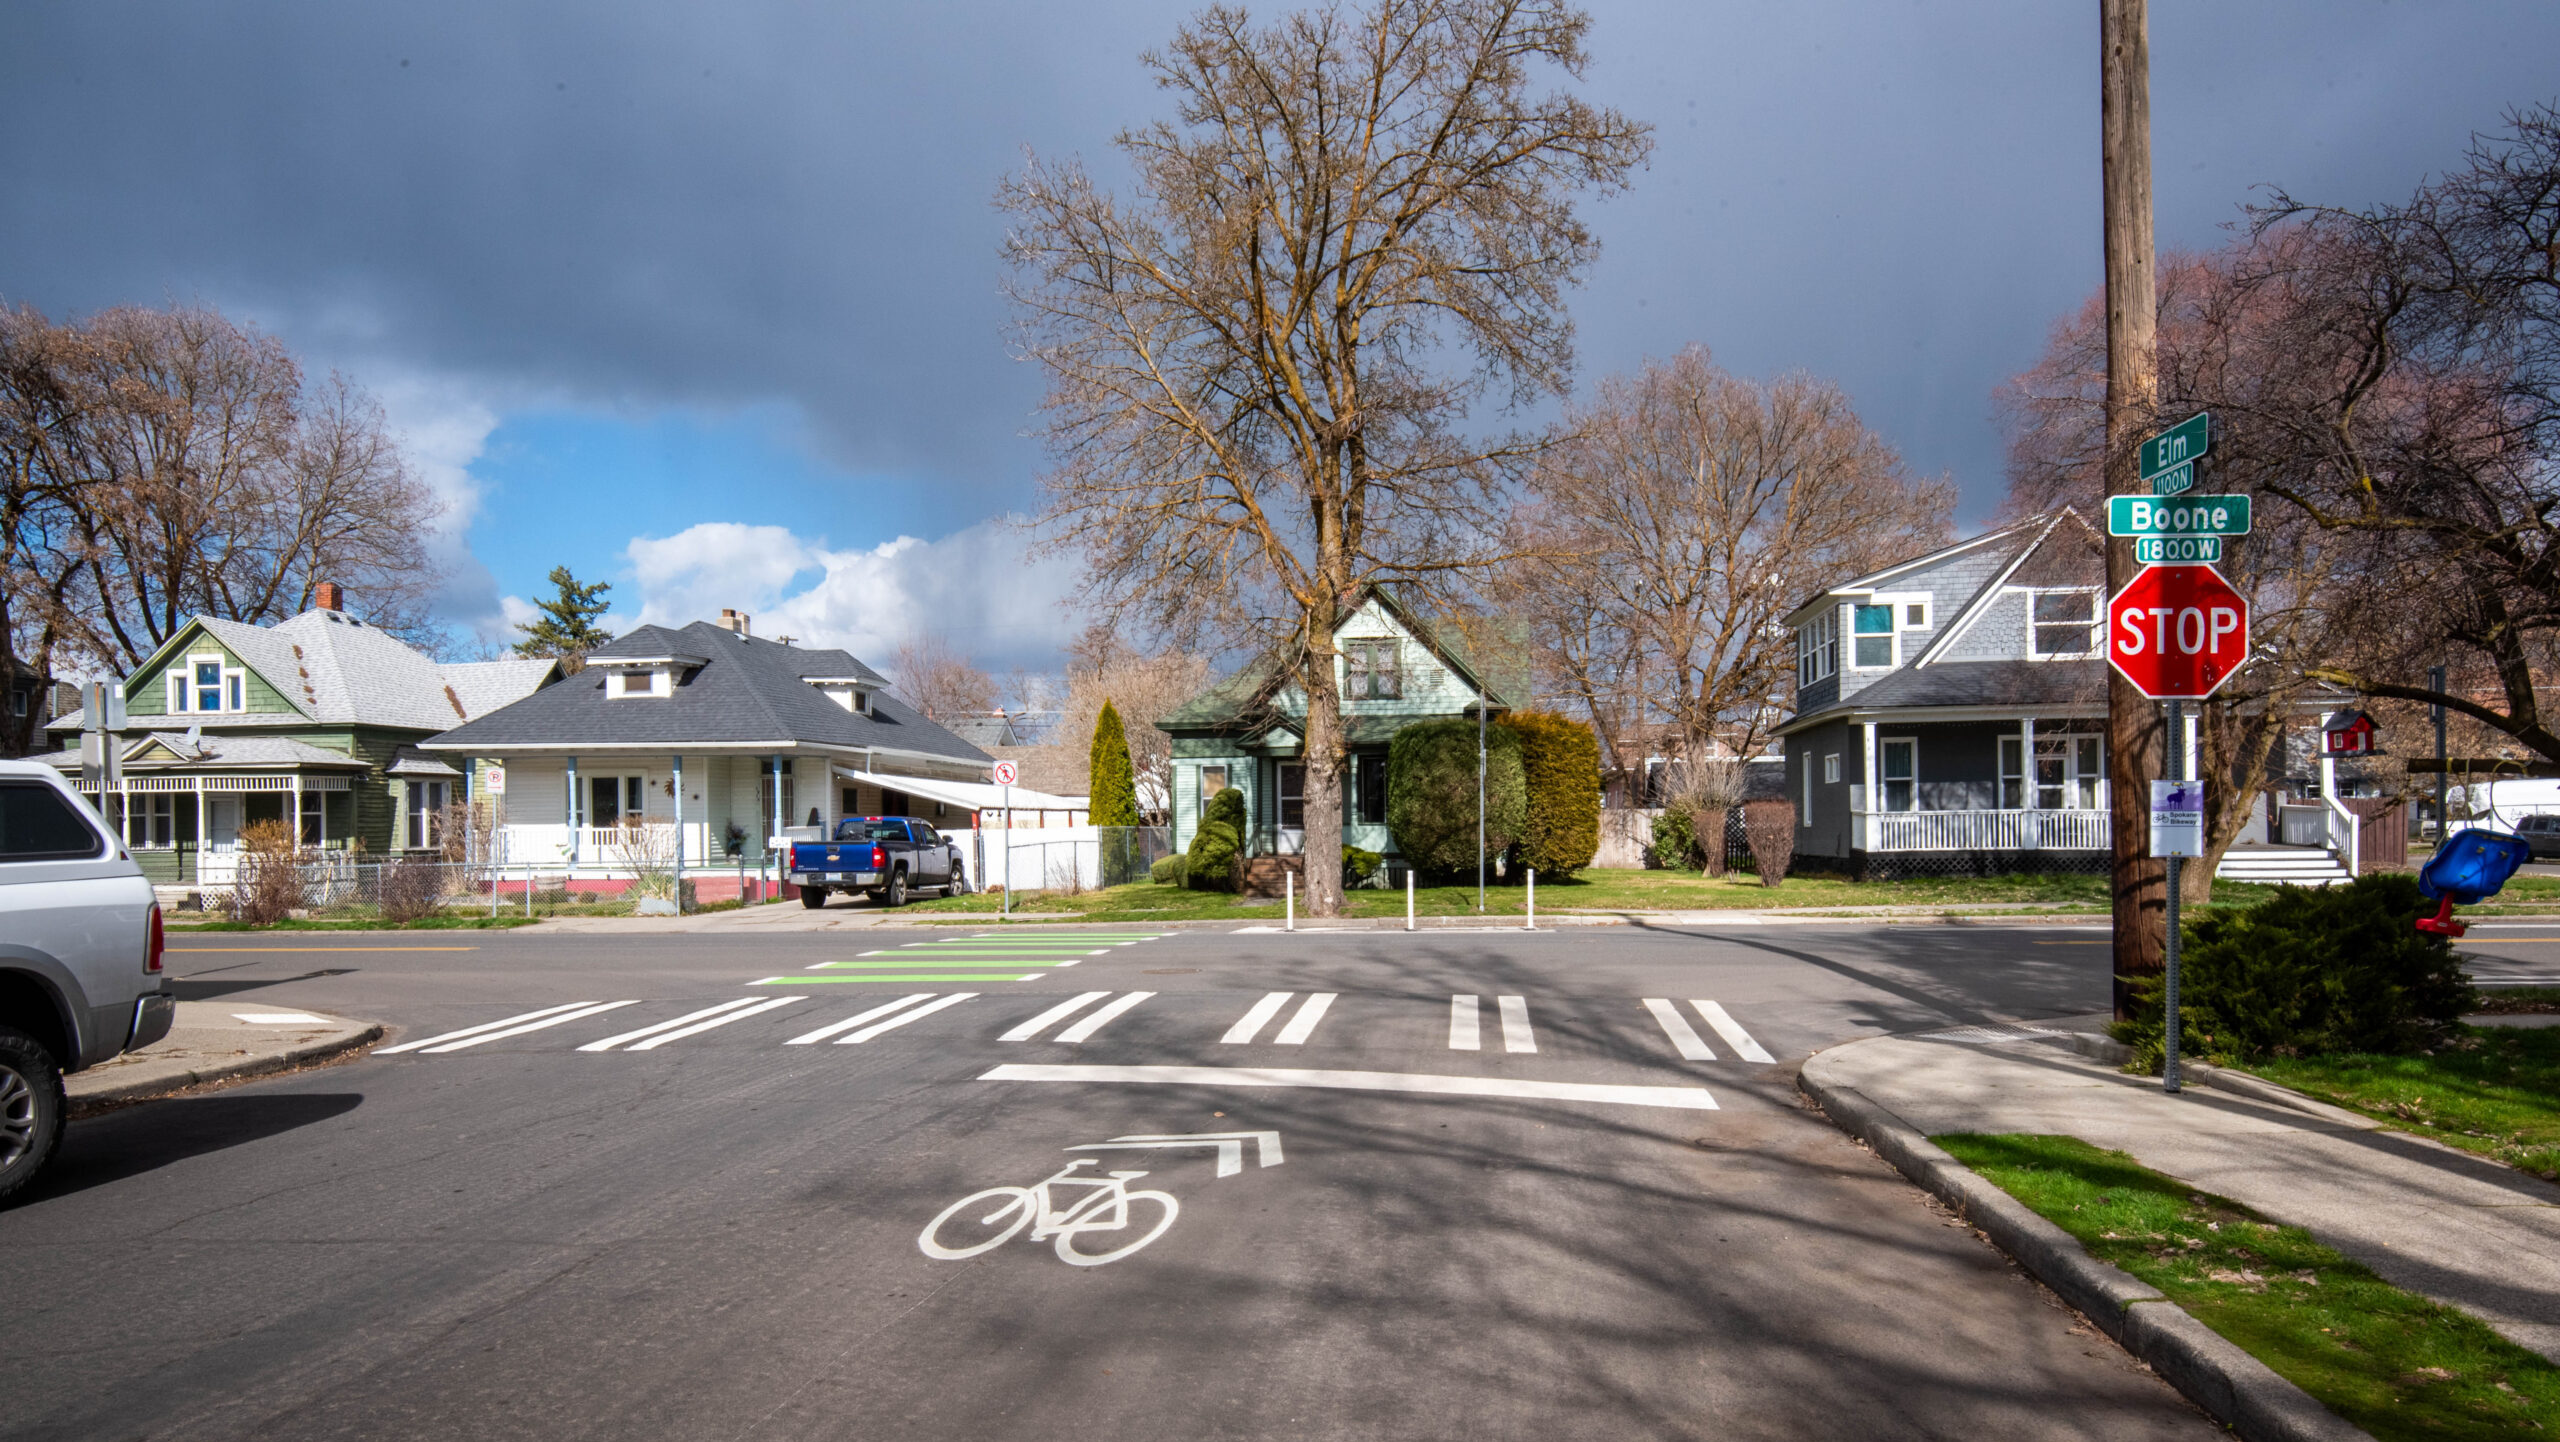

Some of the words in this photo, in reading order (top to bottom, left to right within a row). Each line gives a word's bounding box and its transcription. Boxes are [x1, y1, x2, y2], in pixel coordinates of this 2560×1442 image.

[2158, 435, 2187, 468] Elm
[2156, 467, 2188, 496] 1100N
[2131, 501, 2228, 531] Boone
[2142, 539, 2215, 560] 1800W
[2118, 606, 2238, 656] STOP
